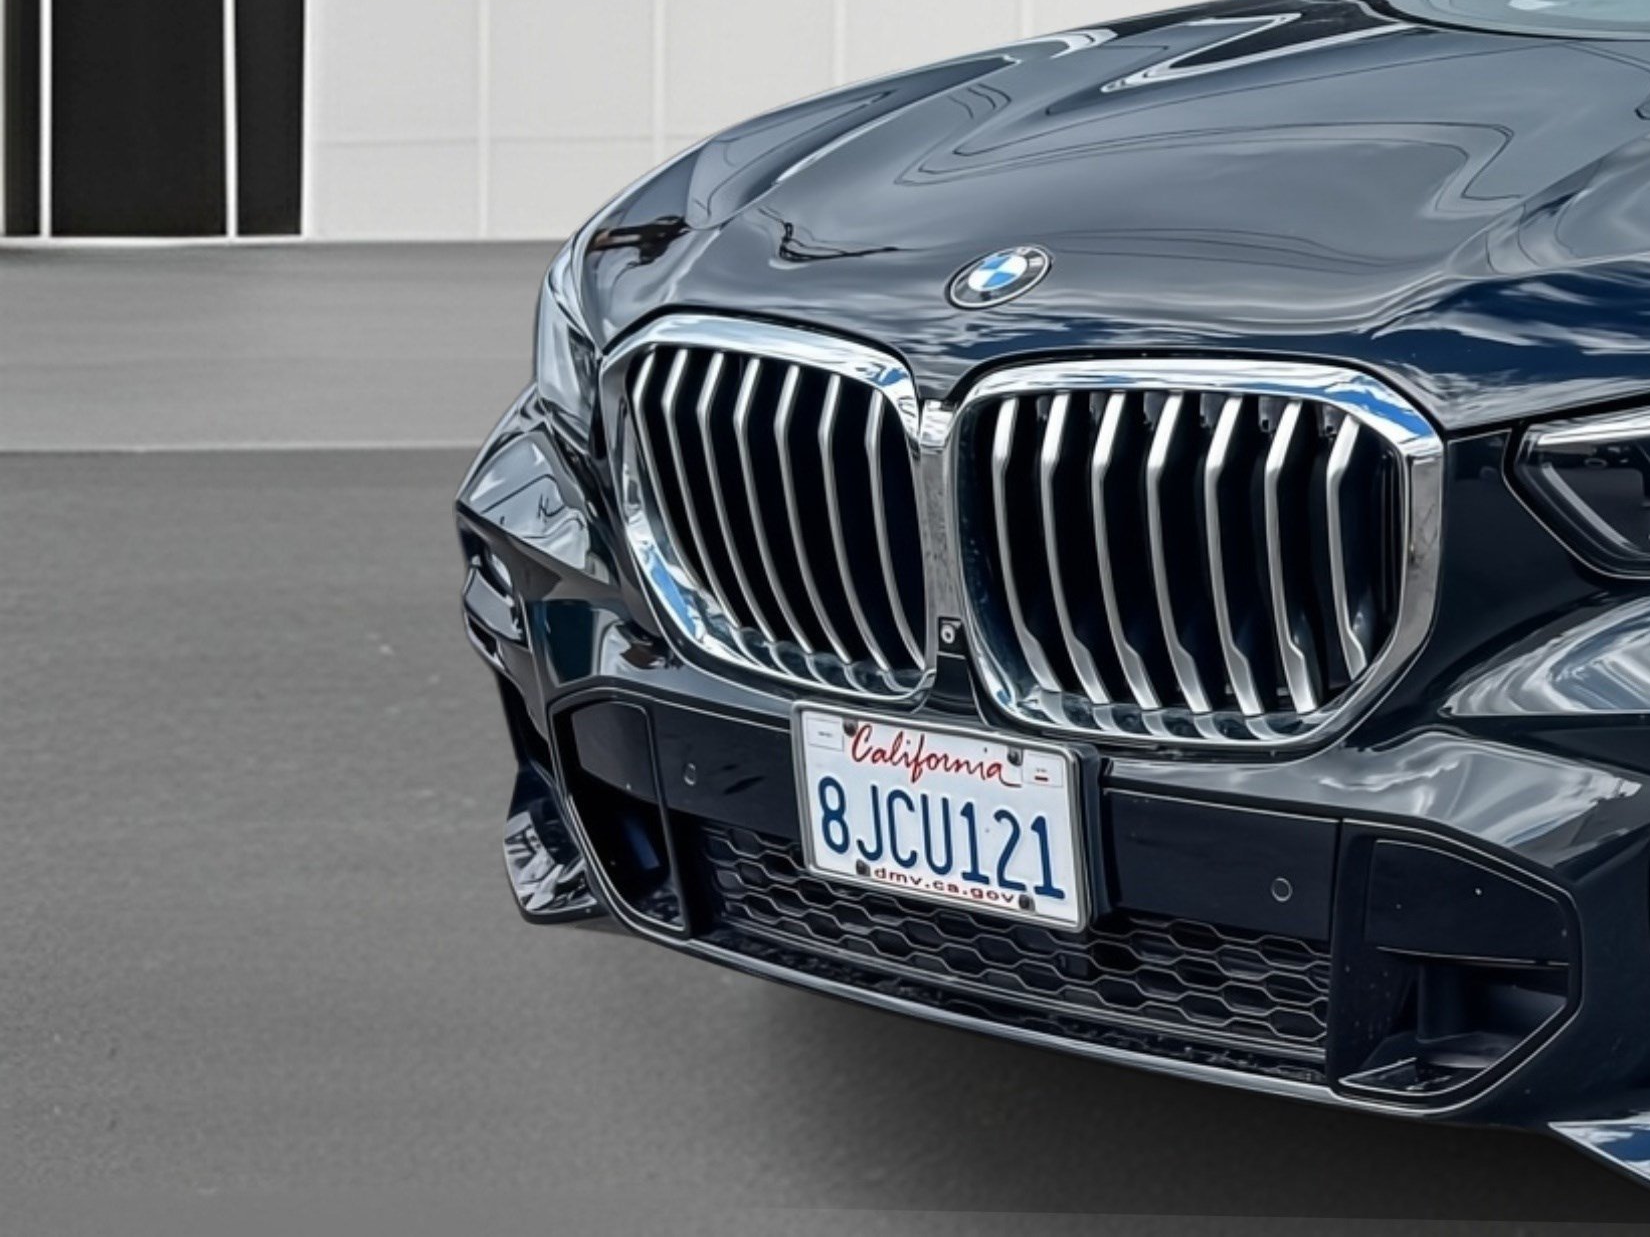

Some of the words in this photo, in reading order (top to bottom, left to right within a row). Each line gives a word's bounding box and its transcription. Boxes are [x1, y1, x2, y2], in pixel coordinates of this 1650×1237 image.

[851, 724, 1022, 788] California
[818, 775, 1066, 900] 8JCU121
[873, 867, 1016, 904] dmv.ca.gov
